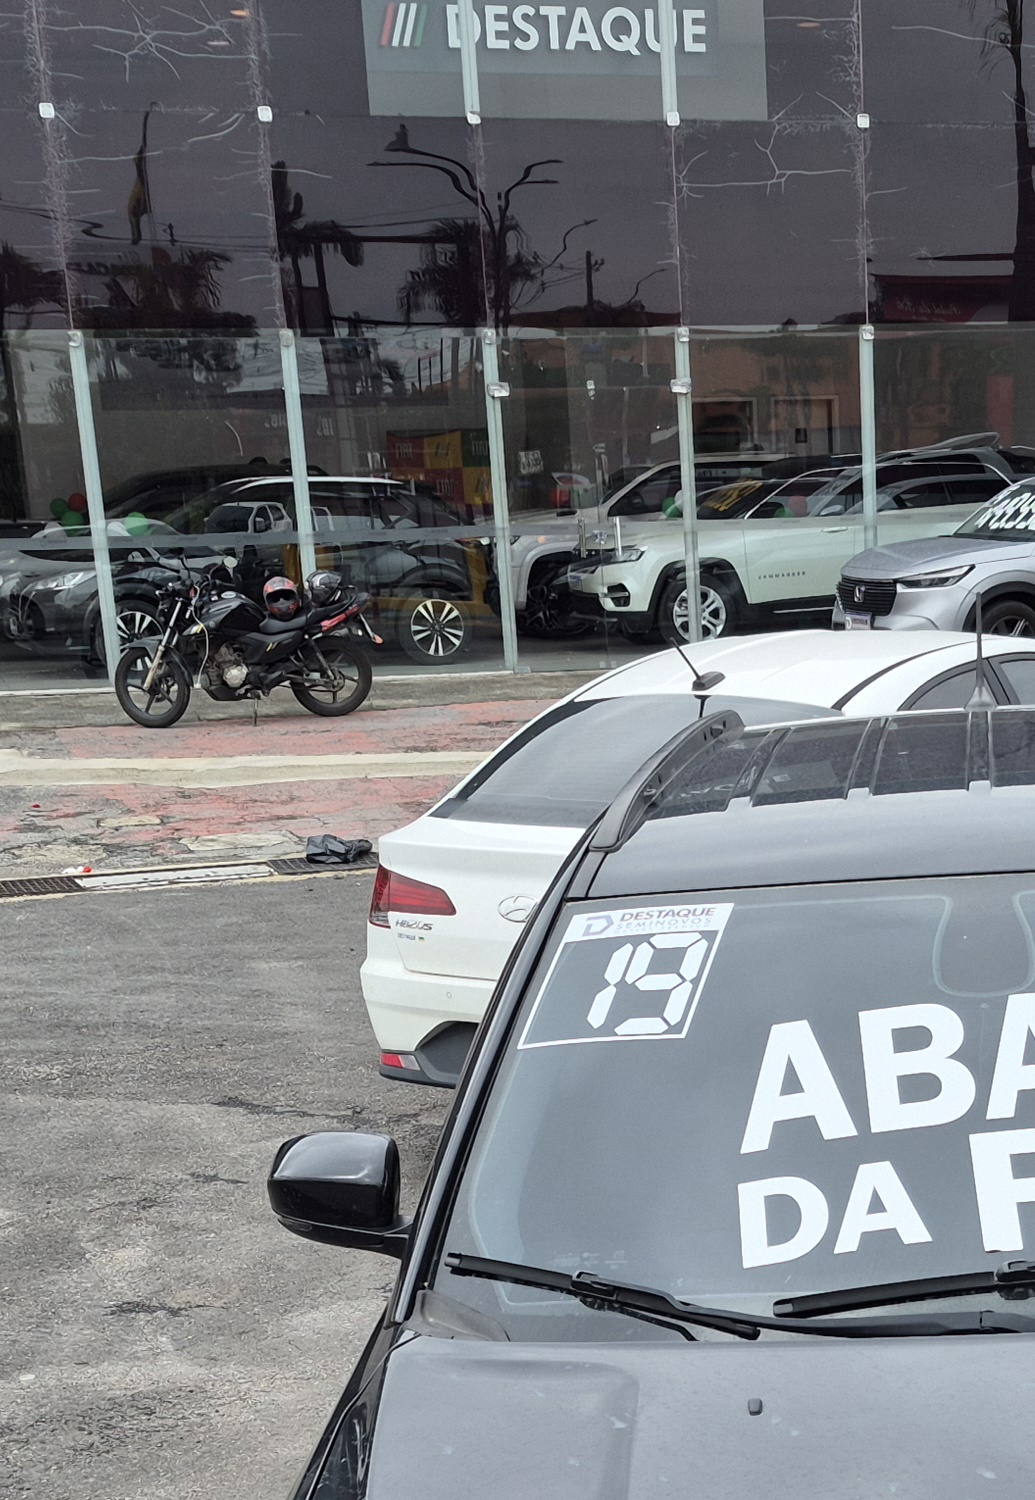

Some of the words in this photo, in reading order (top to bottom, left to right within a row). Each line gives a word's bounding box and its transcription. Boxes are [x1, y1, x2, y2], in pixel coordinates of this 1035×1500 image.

[445, 3, 707, 56] DESTAQUE
[616, 917, 712, 930] SEMINOVOS
[619, 907, 717, 922] DESTAQUE
[586, 931, 709, 1036] 19
[738, 1160, 933, 1269] DA
